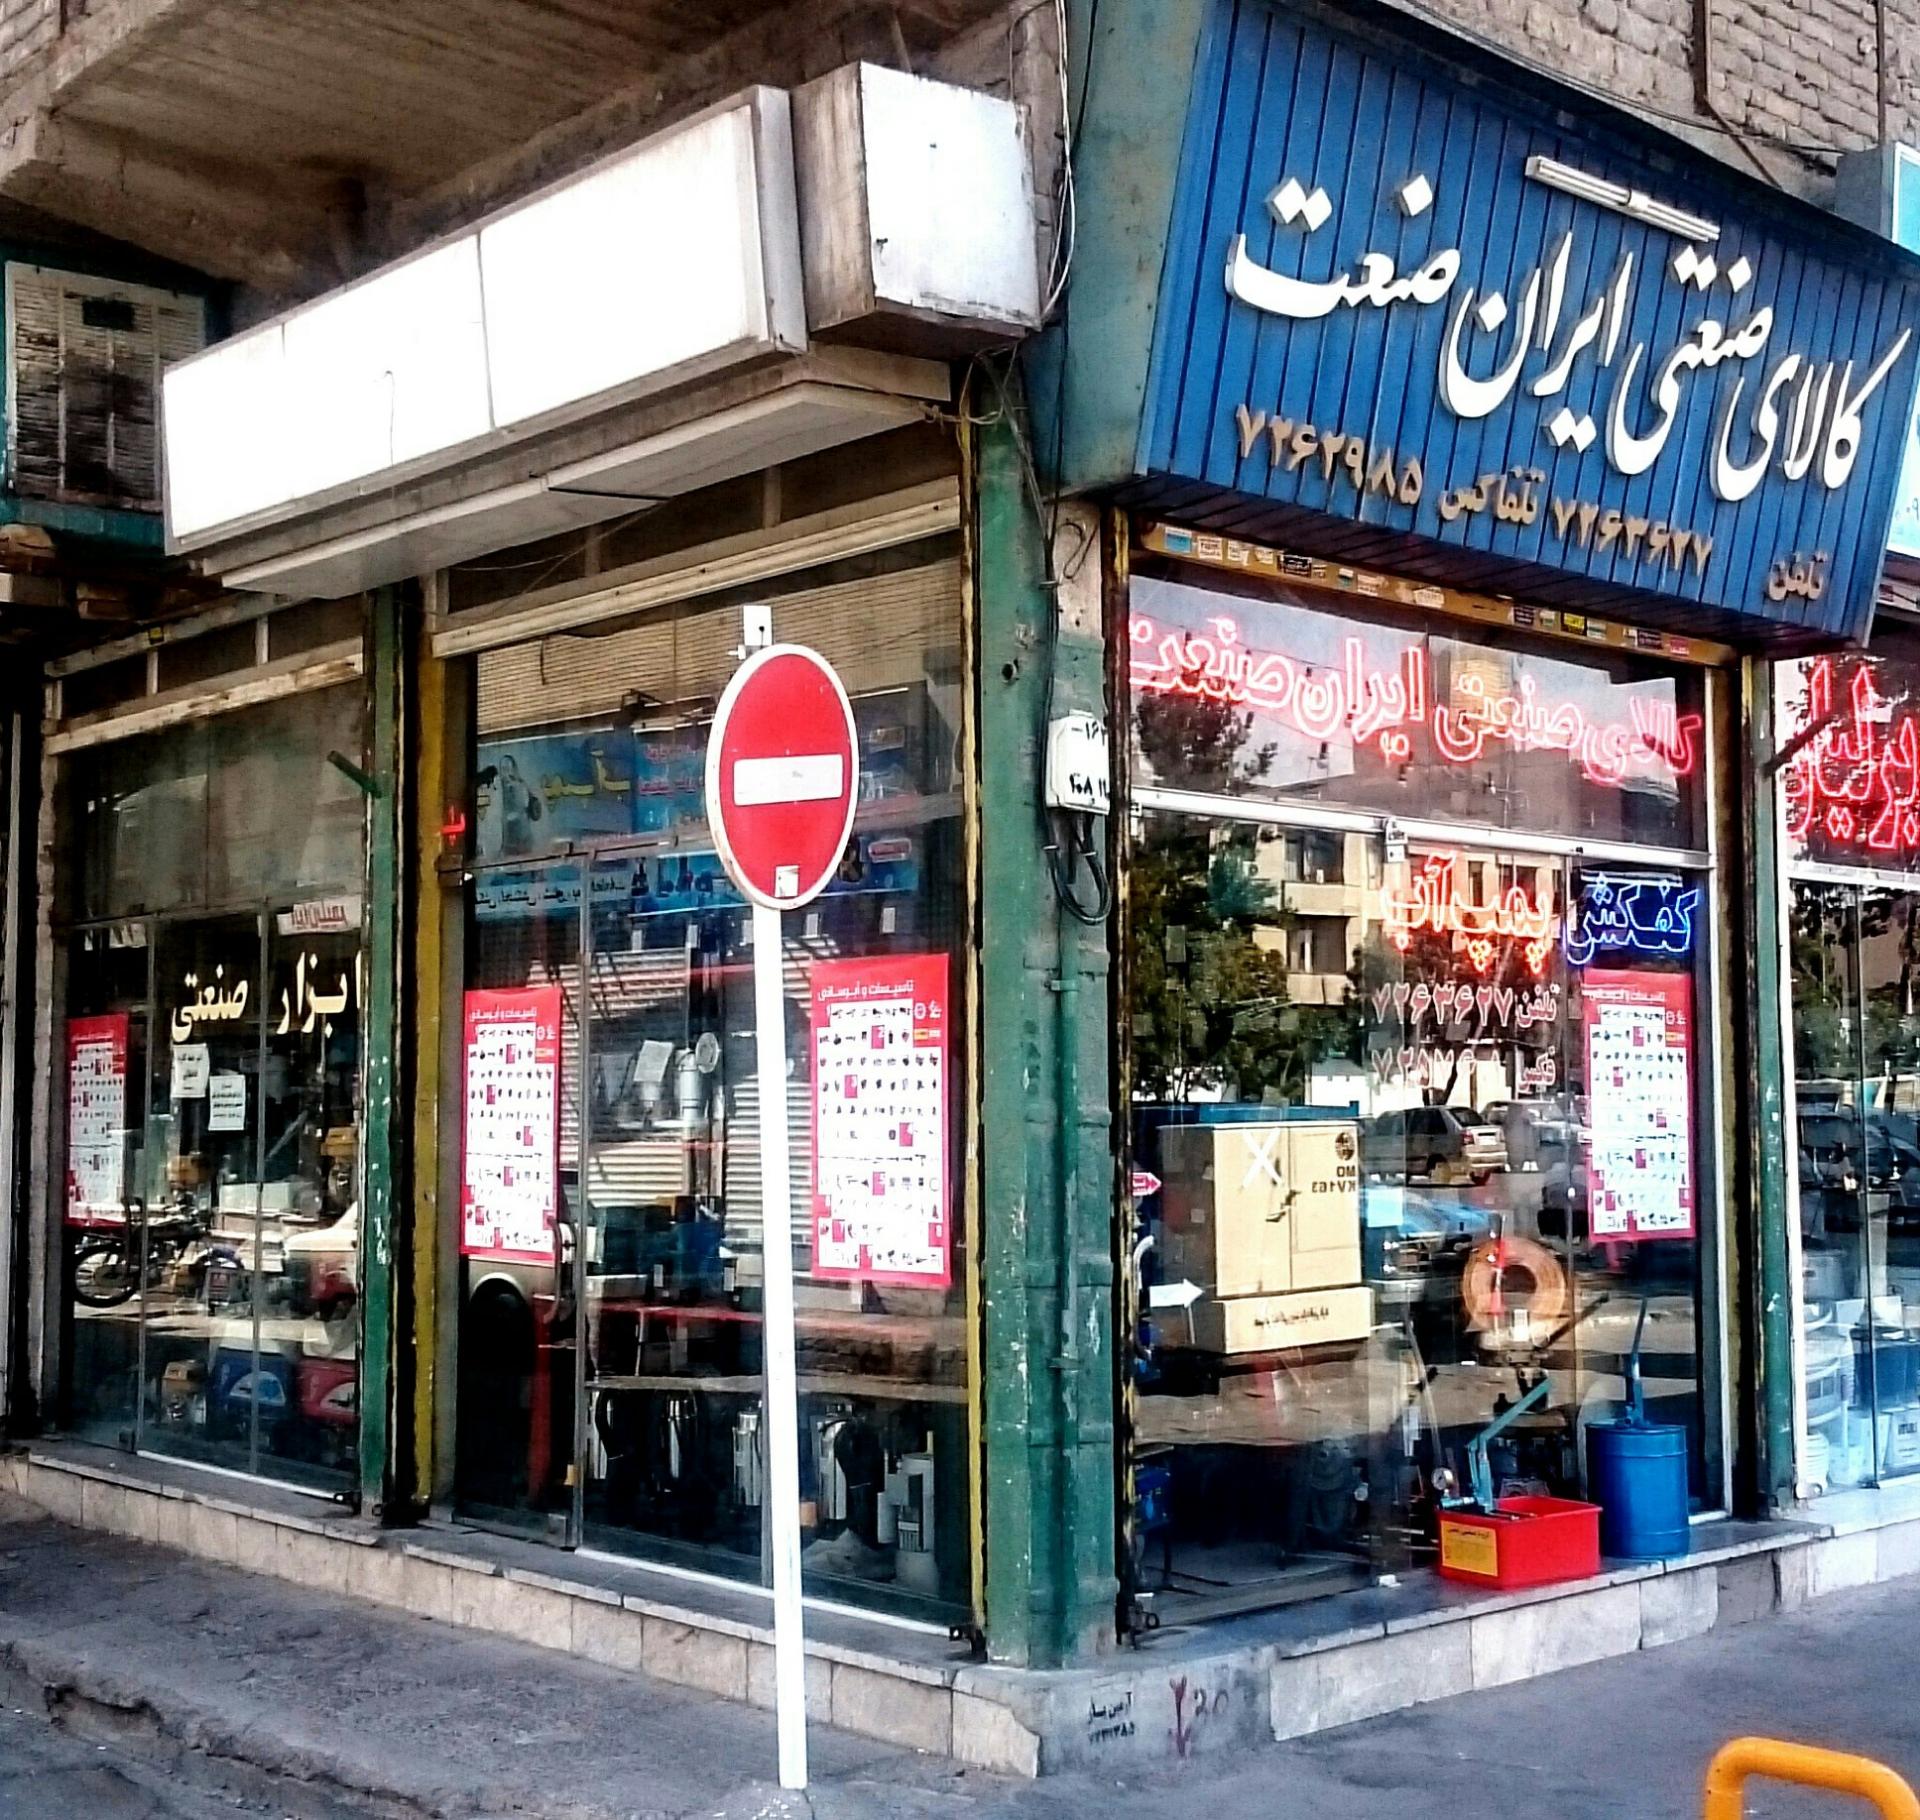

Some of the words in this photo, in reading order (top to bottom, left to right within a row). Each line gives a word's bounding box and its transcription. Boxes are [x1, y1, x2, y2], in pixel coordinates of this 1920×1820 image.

[1225, 173, 1461, 319] صنعت
[1439, 231, 1637, 454] ایران
[1604, 245, 1776, 475] صنعتی
[1711, 328, 1912, 503] کالای
[1766, 551, 1829, 601] تلفن
[1293, 636, 1427, 758] ایران
[1434, 674, 1584, 762] صنعتی
[1582, 694, 1702, 785] کالای
[1379, 852, 1458, 952] آب
[1450, 884, 1550, 975] پمپ
[171, 963, 249, 1043] صنعتی
[276, 950, 362, 1039] ابزار
[1371, 982, 1514, 1028] ۷۲۶۳۶۲۷
[1514, 982, 1561, 1028] تلفن
